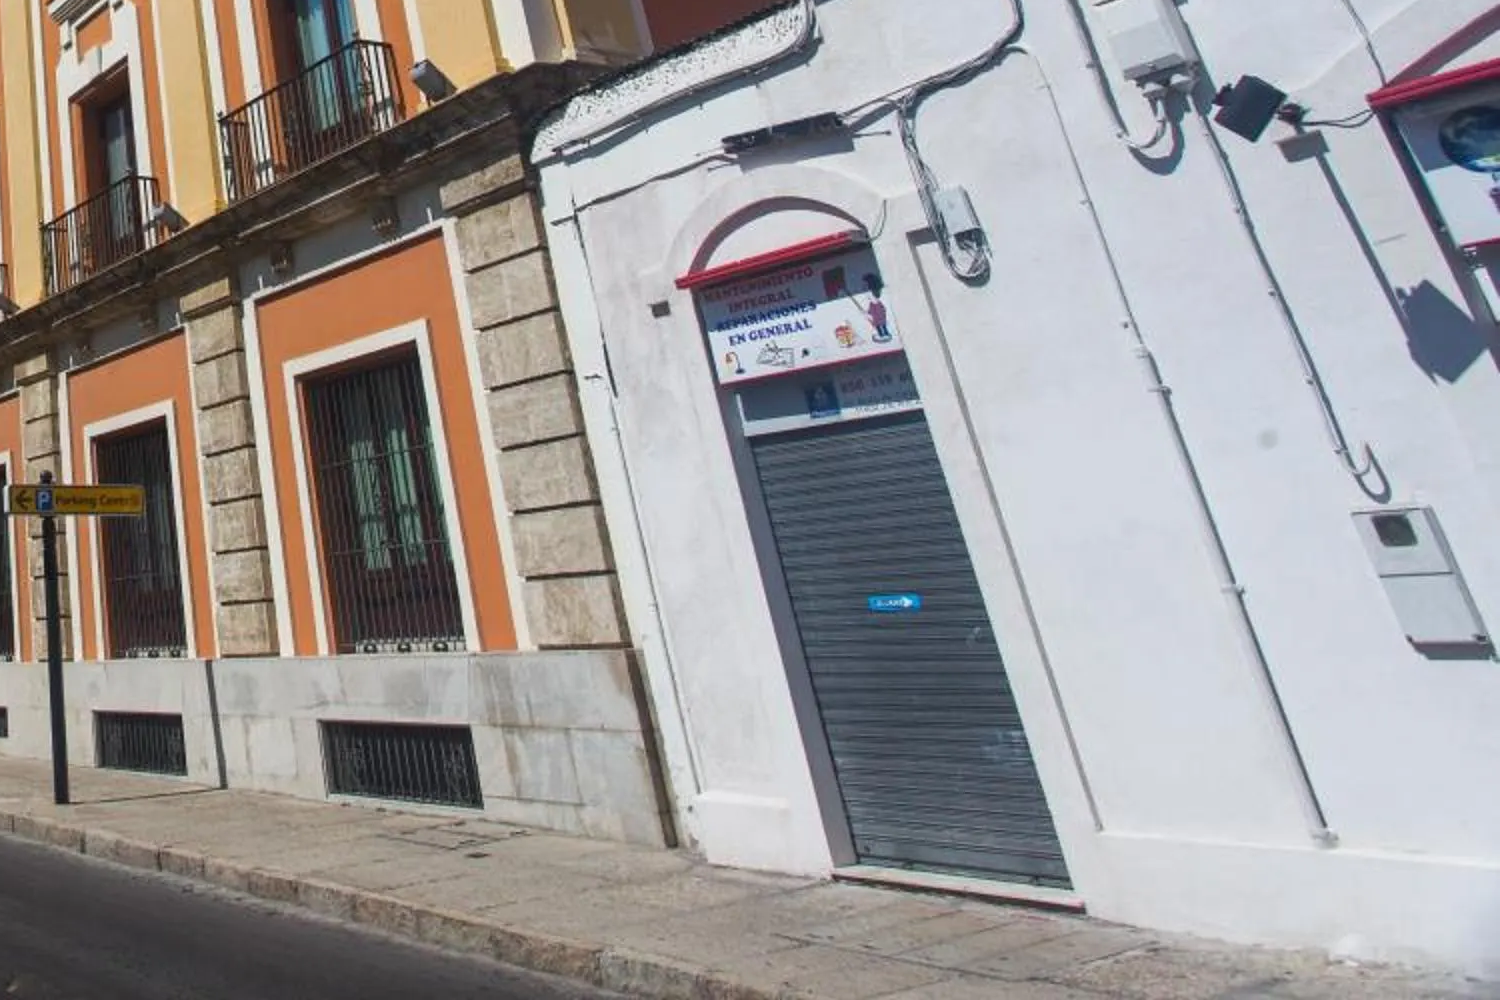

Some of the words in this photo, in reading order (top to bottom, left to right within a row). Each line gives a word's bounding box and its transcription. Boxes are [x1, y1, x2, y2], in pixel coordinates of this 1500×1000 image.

[729, 288, 794, 313] INTEGRAL
[716, 300, 817, 330] REPARACIONES
[728, 334, 747, 346] EN
[749, 318, 813, 340] GENERAL
[39, 491, 51, 510] P
[55, 494, 96, 508] Parking
